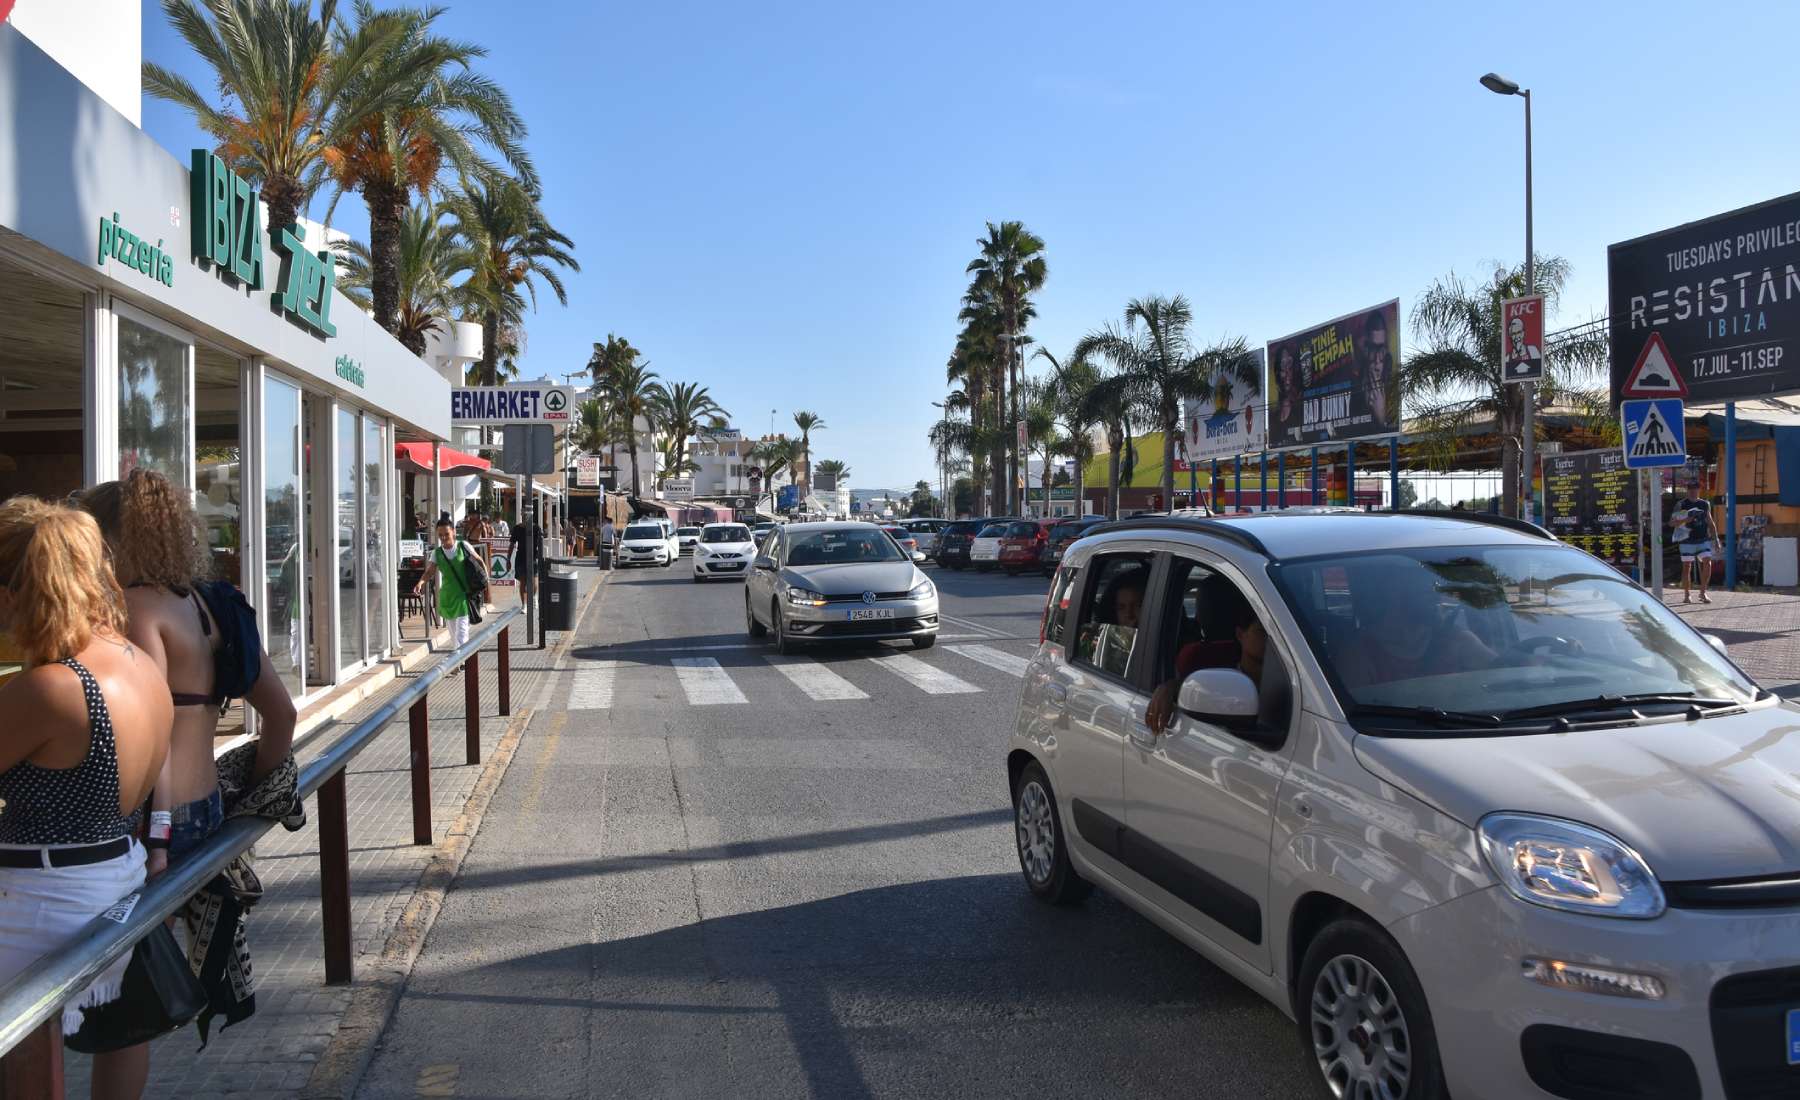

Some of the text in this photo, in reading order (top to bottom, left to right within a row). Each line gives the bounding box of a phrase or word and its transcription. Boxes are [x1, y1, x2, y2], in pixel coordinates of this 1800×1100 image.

[191, 149, 264, 291] IBIZA
[1666, 238, 1732, 273] TUESDAYS
[1510, 301, 1537, 317] KFC
[1311, 325, 1337, 354] TINIE
[1708, 312, 1767, 339] IBIZA
[1312, 334, 1354, 372] TEMPAH
[452, 390, 540, 419] ERMARKET
[1303, 398, 1320, 425] BAD
[1321, 392, 1351, 422] BUNNY
[577, 458, 597, 468] SUSHI
